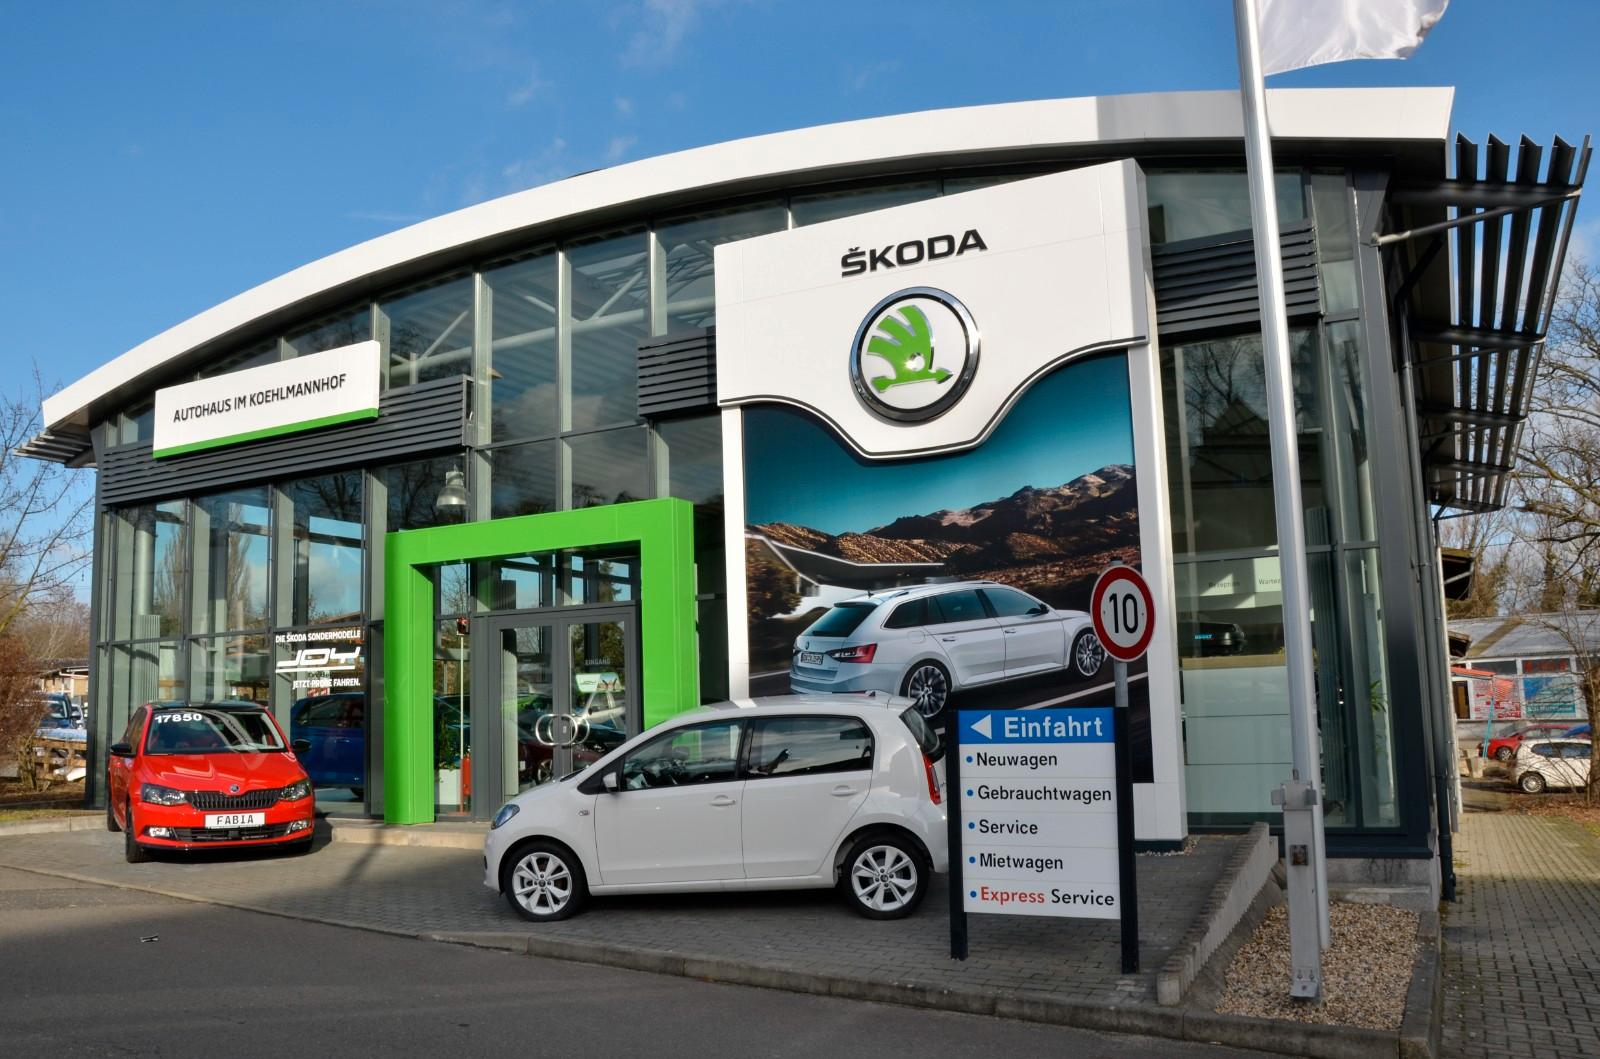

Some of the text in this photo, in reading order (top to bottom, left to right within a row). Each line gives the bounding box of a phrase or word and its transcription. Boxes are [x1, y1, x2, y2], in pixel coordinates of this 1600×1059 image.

[841, 229, 988, 278] ŠKODA
[173, 373, 347, 423] AUTOHAUS IM KOEHLMANNHOF
[1109, 593, 1138, 634] 10
[275, 630, 361, 643] DIE ŠKODA SONDERMODELLE
[276, 646, 361, 667] JOY
[333, 677, 361, 687] FAHREN.
[155, 713, 203, 723] 17850
[1004, 716, 1103, 738] Einfahrt
[976, 752, 1058, 770] Neuwagen
[978, 785, 1112, 804] Gebrauchtwagen
[216, 814, 254, 825] FABIA
[979, 819, 1039, 834] Service
[979, 853, 1064, 873] Mietwagen
[980, 886, 1115, 906] Express Service
